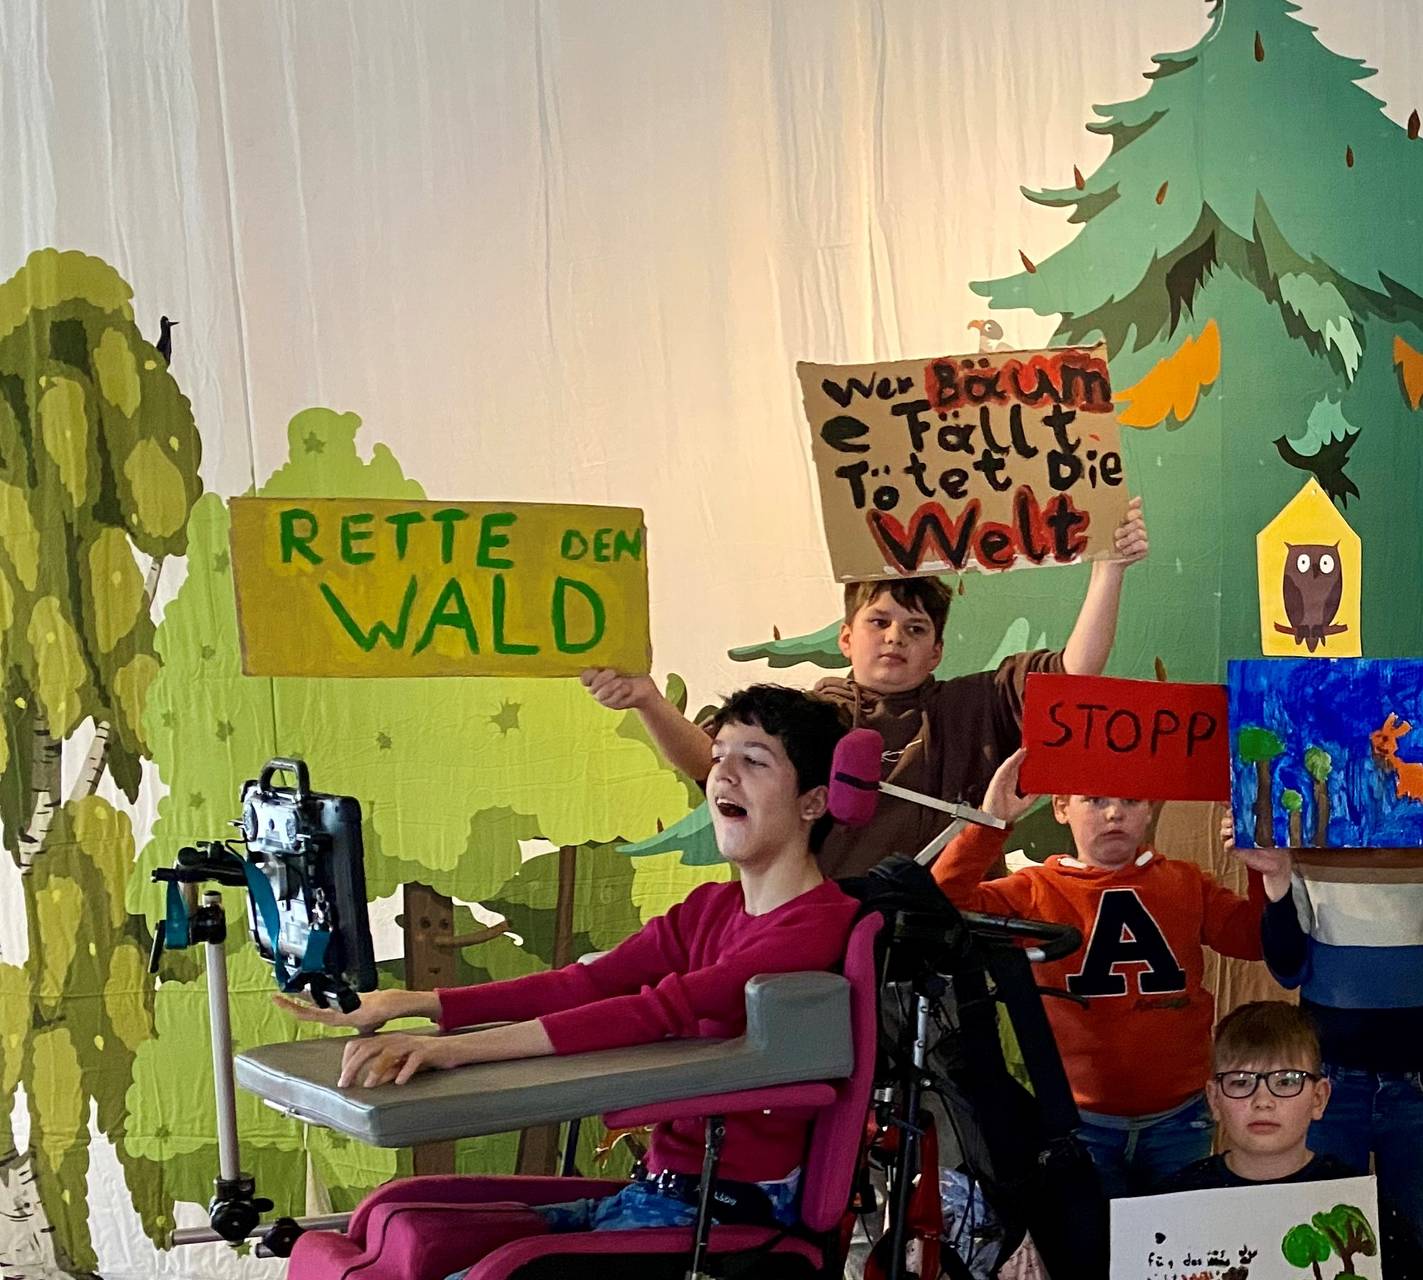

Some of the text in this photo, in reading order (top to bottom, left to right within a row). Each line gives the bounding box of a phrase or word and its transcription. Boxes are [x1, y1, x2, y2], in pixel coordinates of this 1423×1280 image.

[279, 508, 641, 570] RETTE DEN
[866, 484, 1090, 576] Welt
[319, 573, 607, 657] WALD
[1042, 700, 1218, 758] STOPP
[1065, 888, 1188, 998] A
